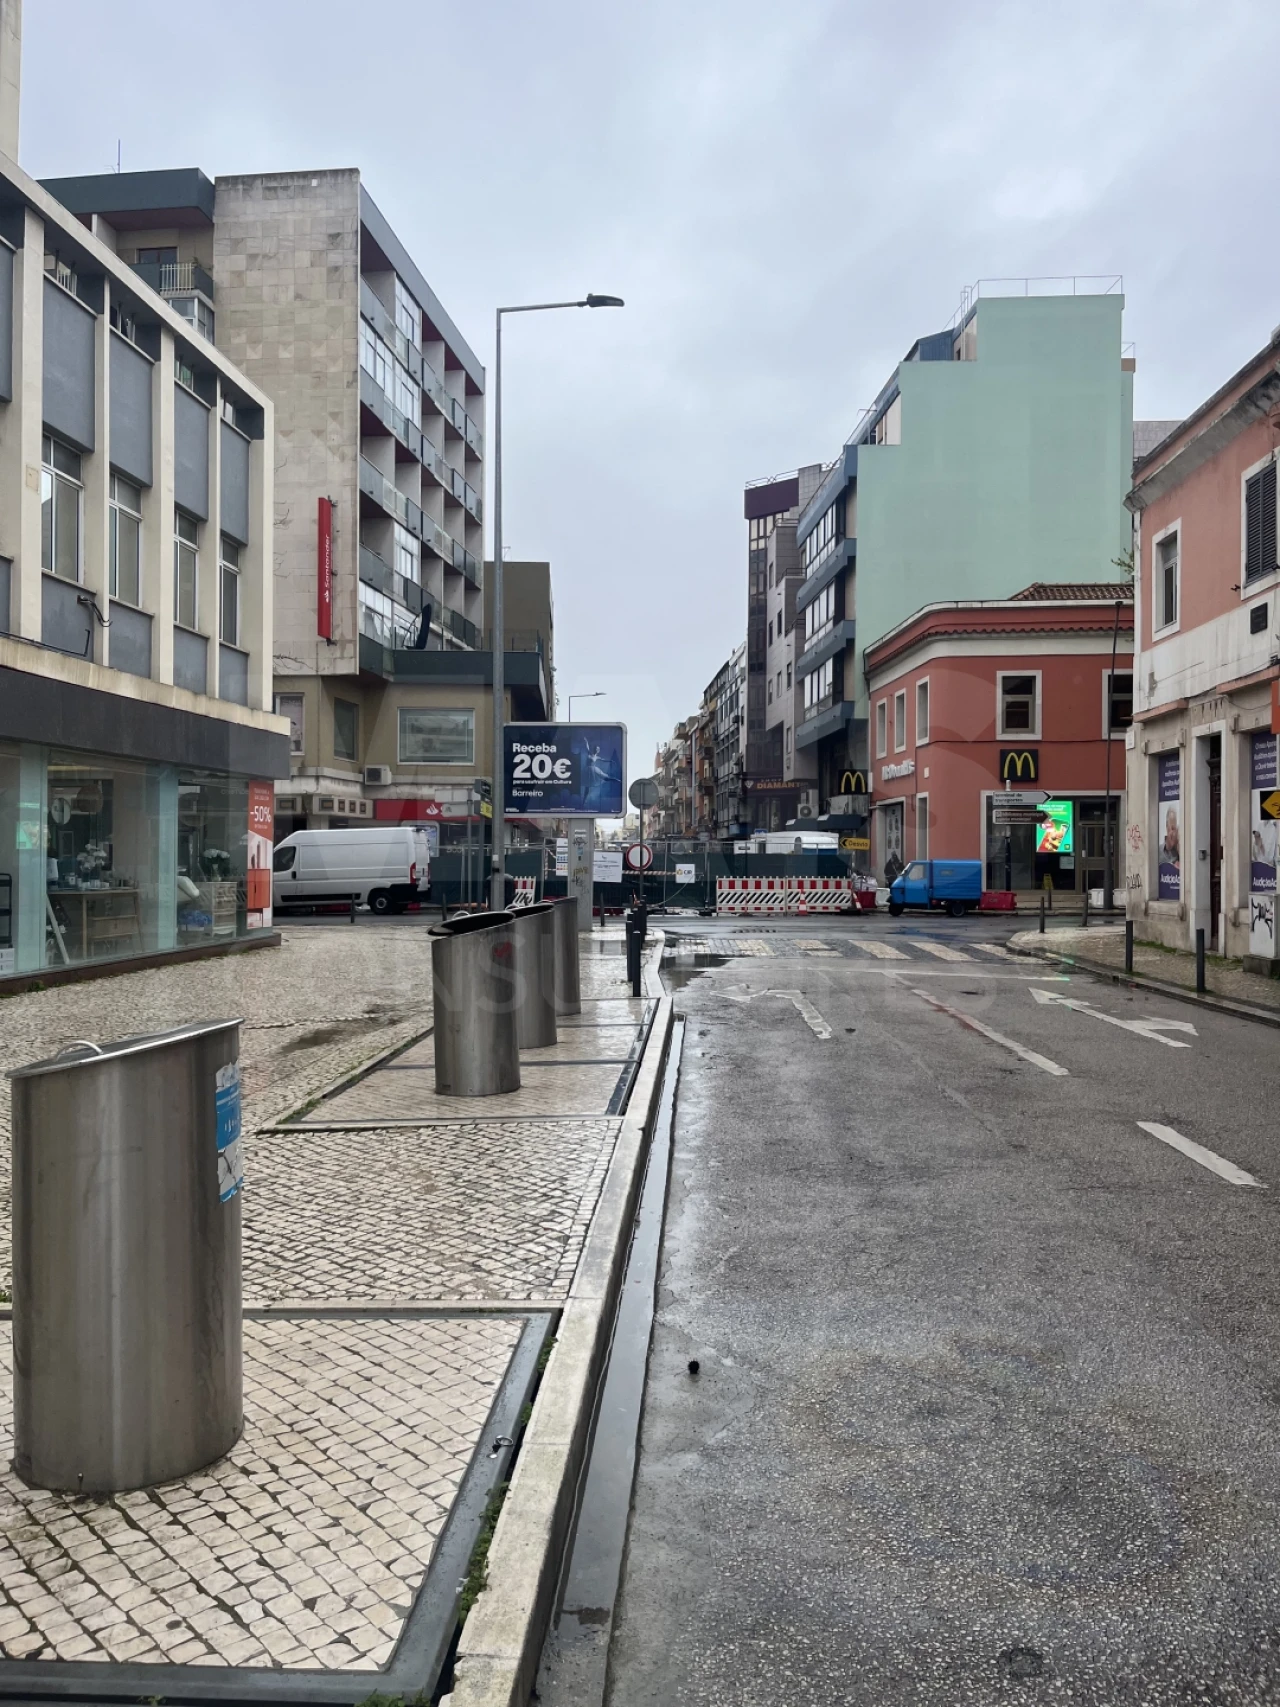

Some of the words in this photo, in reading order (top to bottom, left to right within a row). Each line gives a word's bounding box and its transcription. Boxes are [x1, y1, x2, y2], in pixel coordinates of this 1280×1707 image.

[512, 743, 557, 753] Receba
[512, 753, 572, 779] 20€
[512, 789, 544, 797] Barreiro
[250, 805, 272, 823] -50%
[848, 840, 868, 848] Desvio
